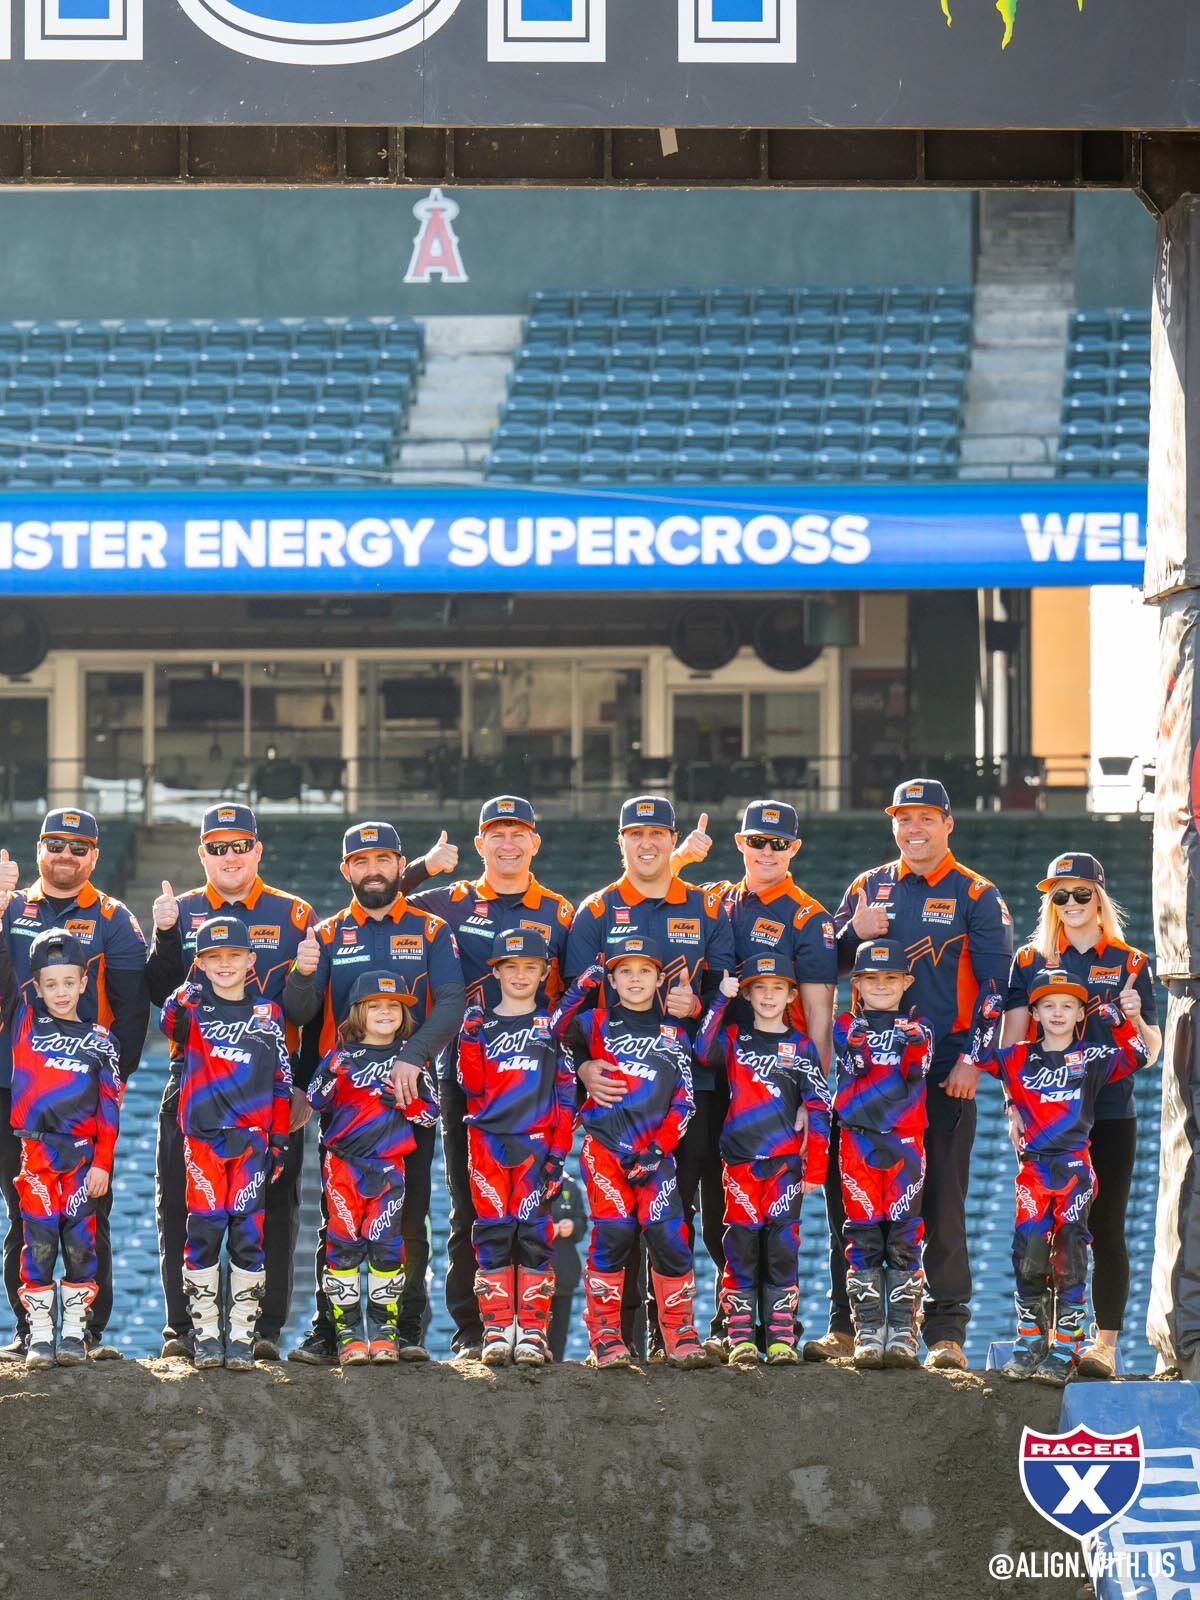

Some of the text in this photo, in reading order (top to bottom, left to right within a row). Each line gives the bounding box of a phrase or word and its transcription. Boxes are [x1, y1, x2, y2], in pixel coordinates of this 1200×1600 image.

[184, 518, 436, 568] ENERGY
[448, 516, 871, 567] SUPERCROSS
[759, 923, 779, 934] KTM
[210, 1046, 252, 1064] KTM
[781, 1045, 793, 1054] 13
[44, 1057, 90, 1074] KTM
[497, 1056, 539, 1073] KTM
[617, 1061, 657, 1081] KTM
[1040, 1088, 1081, 1103] KTM
